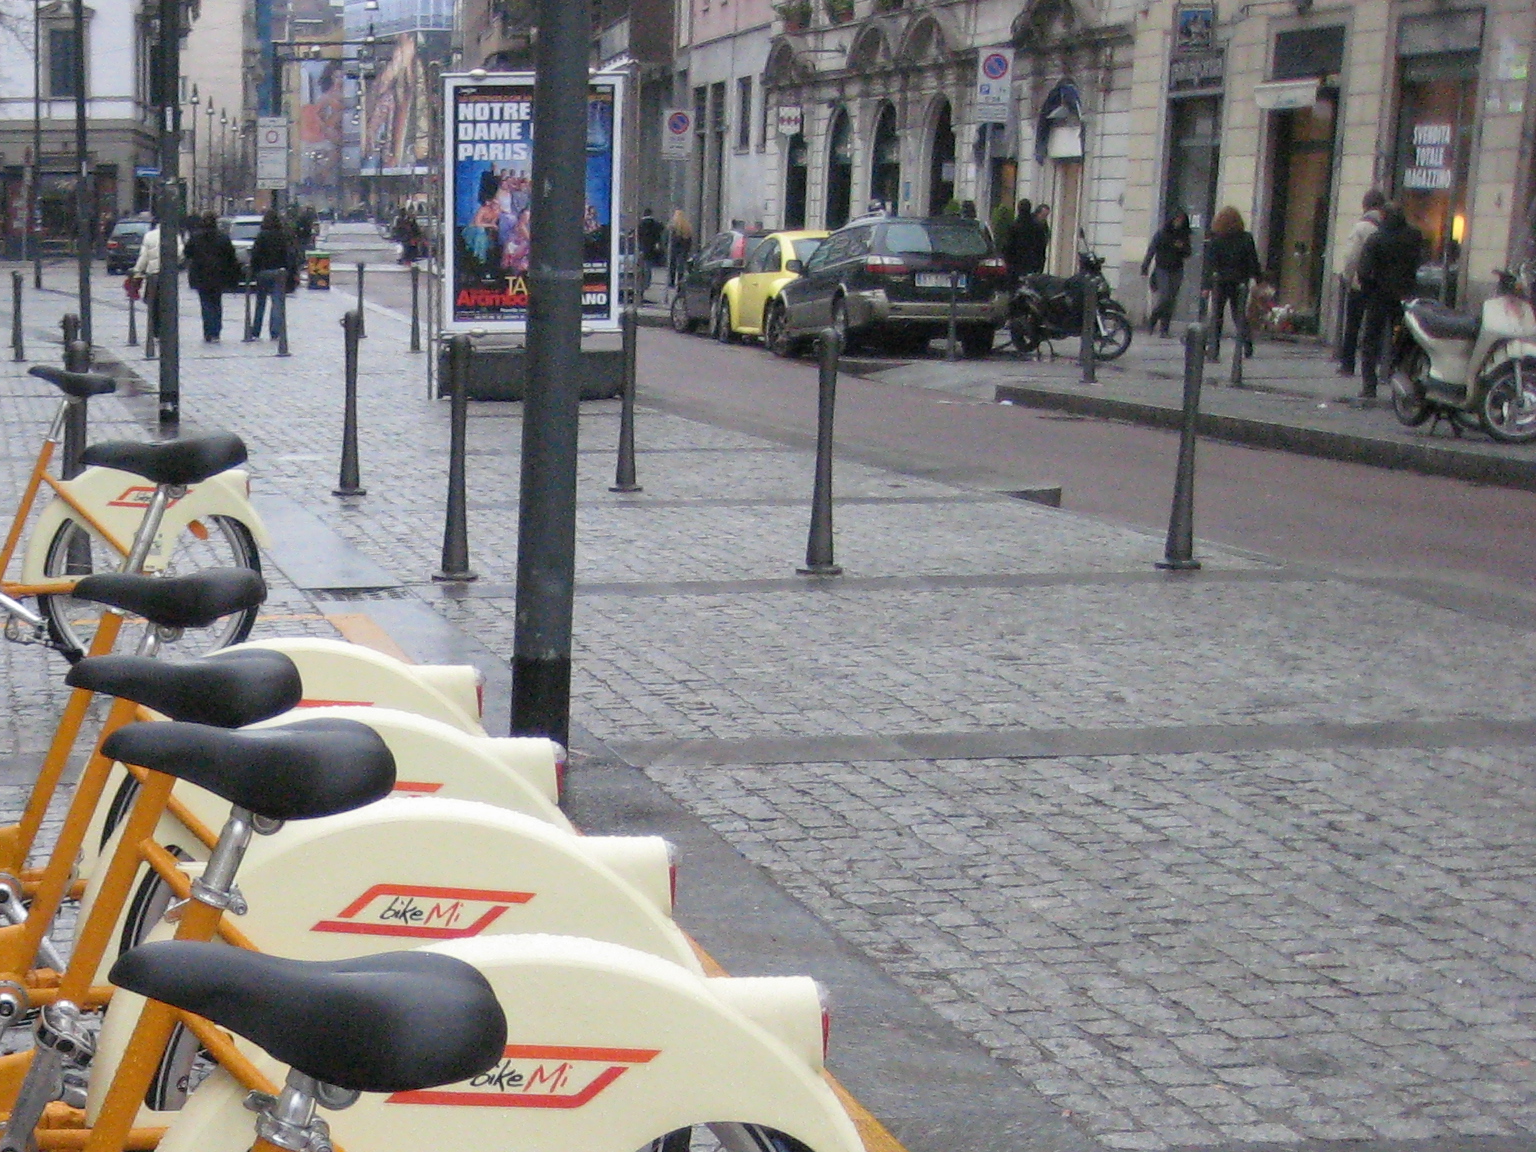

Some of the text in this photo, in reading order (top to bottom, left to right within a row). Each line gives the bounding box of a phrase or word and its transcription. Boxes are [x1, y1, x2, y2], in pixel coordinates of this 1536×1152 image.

[458, 102, 530, 120] NOTRE
[458, 122, 522, 140] DAME
[458, 143, 527, 161] PARIS
[379, 896, 464, 927] bikeMi
